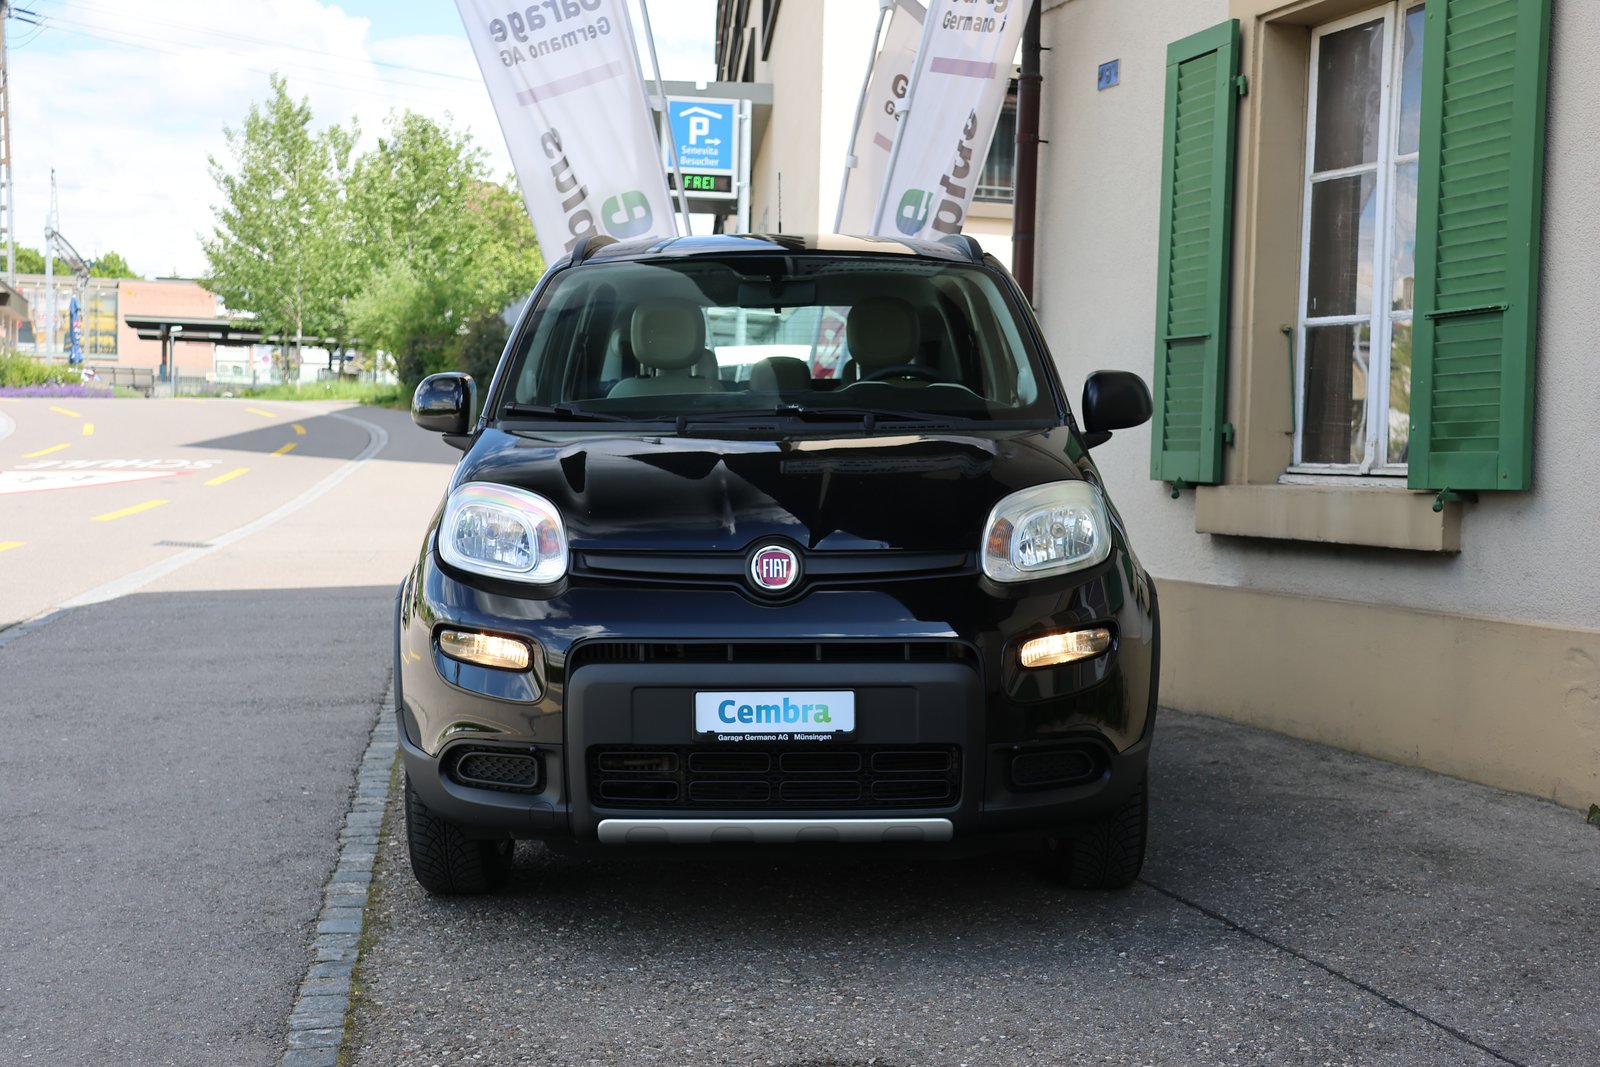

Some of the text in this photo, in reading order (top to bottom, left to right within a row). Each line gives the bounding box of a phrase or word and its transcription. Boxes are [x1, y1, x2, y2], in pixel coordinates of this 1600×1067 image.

[689, 116, 709, 145] P
[681, 145, 719, 156] Senevita
[680, 156, 719, 166] Besucher
[684, 175, 715, 190] FREI
[762, 558, 789, 578] FIAT
[718, 697, 832, 724] Cembra
[718, 734, 744, 742] Garage
[794, 733, 832, 742] Münsingen
